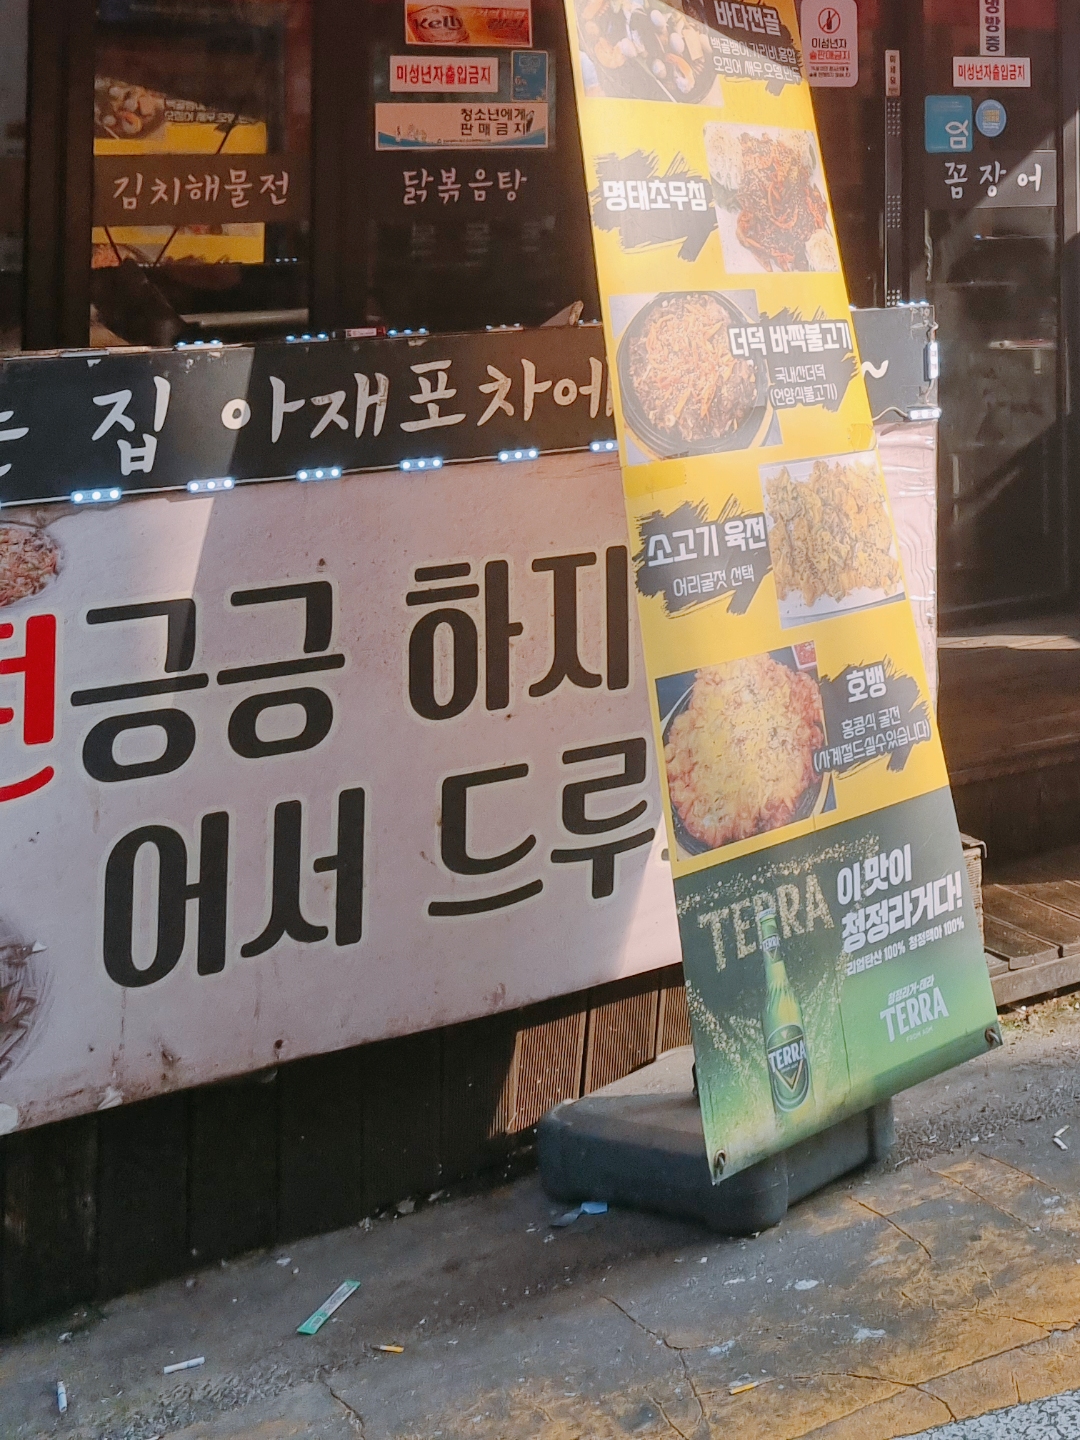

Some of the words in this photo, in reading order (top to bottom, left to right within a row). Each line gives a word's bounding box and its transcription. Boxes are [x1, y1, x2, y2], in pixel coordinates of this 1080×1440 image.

[415, 14, 463, 31] Kelly
[713, 0, 781, 37] 바다전골
[396, 64, 492, 85] 미성년자출입금지
[713, 56, 742, 75] 오징어
[957, 62, 1026, 82] 미성년자출입금지
[461, 108, 527, 122] 청소년에게
[112, 168, 292, 210] 김치해물전
[402, 166, 528, 206] 닭볶음탕
[602, 179, 708, 212] 명태초무침
[943, 160, 1042, 200] 꼼장어
[728, 326, 767, 357] 더덕
[774, 363, 827, 385] 국내산더덕
[770, 383, 838, 407] (언양식불고기)
[92, 375, 171, 476] 집
[648, 525, 720, 567] 소고기
[724, 516, 767, 553] 육전
[673, 568, 727, 598] 어리굴젓
[730, 564, 755, 587] 선택
[405, 545, 628, 721] 하지
[846, 664, 887, 703] 호뱅
[841, 712, 877, 740] 홍콩식
[878, 705, 901, 729] 굴전
[813, 719, 931, 772] (사계절드실수있습니다)
[103, 786, 366, 989] 어서
[428, 736, 671, 919] 드루
[837, 843, 912, 906] 이맛이
[698, 873, 835, 973] TERRA
[841, 870, 964, 954] 청정라거다!
[884, 940, 906, 962] 100%
[944, 915, 965, 936] 100%
[879, 986, 950, 1043] TERRA
[767, 1039, 808, 1074] TERRA
